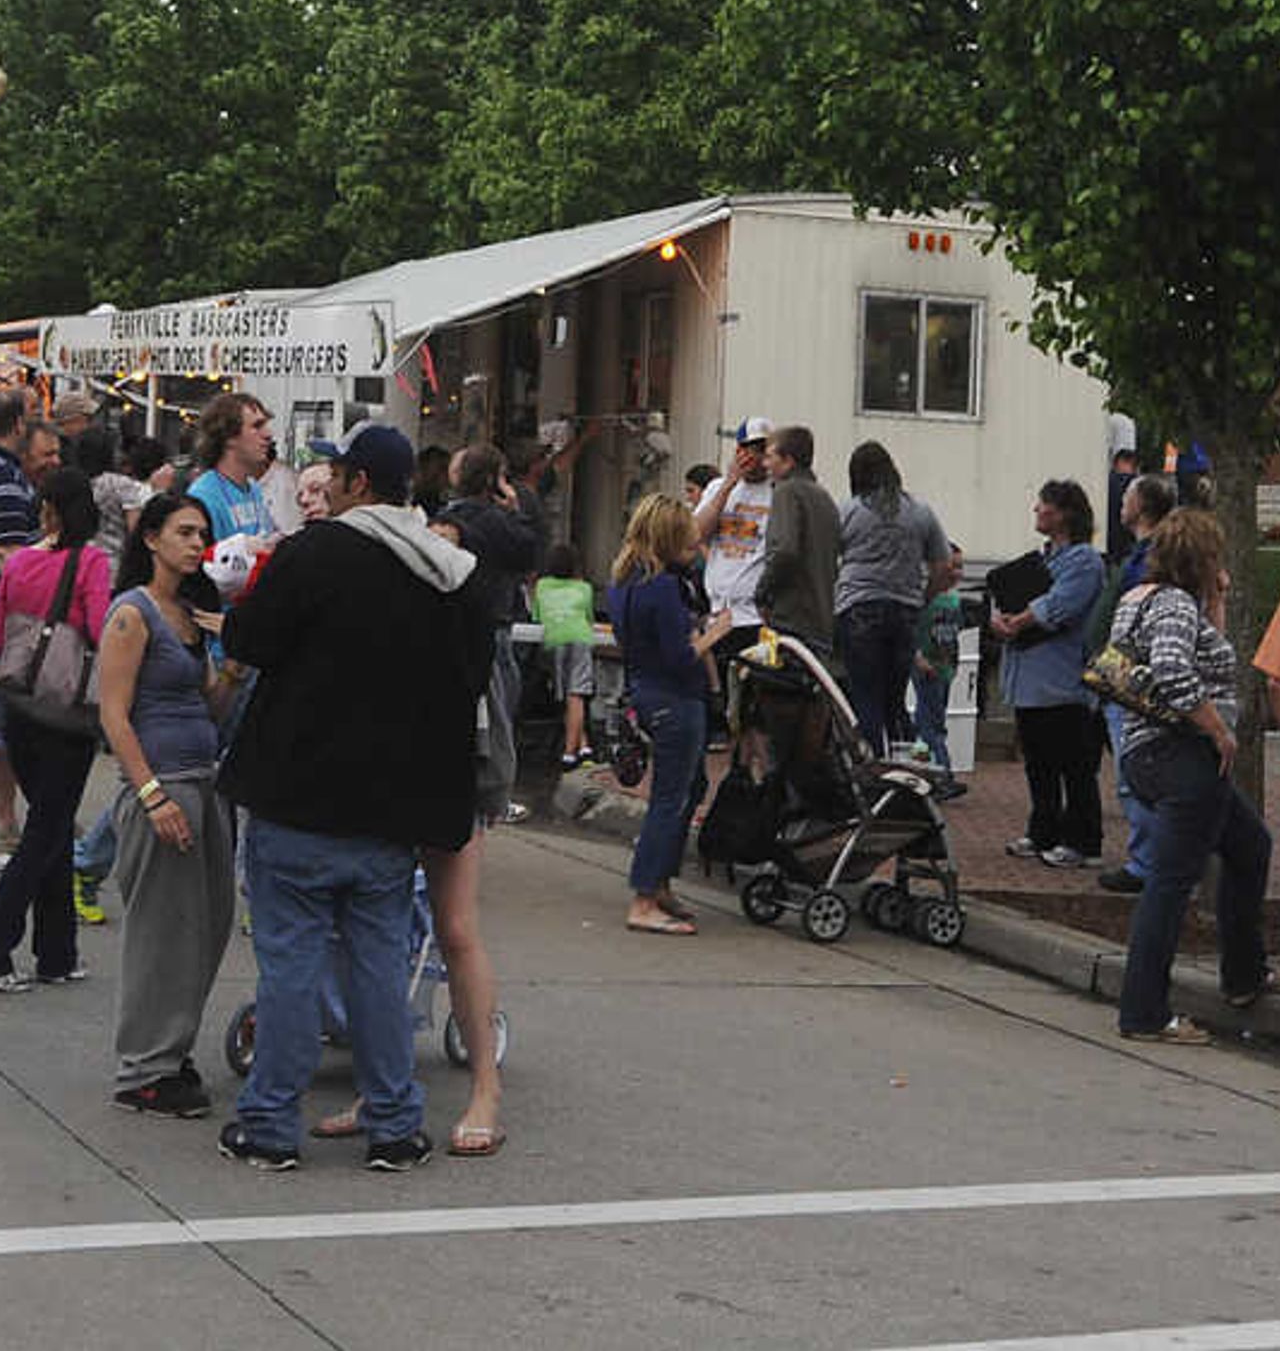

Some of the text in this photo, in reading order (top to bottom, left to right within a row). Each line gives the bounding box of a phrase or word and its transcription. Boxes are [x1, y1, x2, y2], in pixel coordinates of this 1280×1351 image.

[111, 307, 290, 339] PERRYVILLE BASSCASTERS
[151, 347, 169, 372] HOT
[174, 347, 205, 371] DOGS
[222, 344, 348, 374] CHEESEBURGERS
